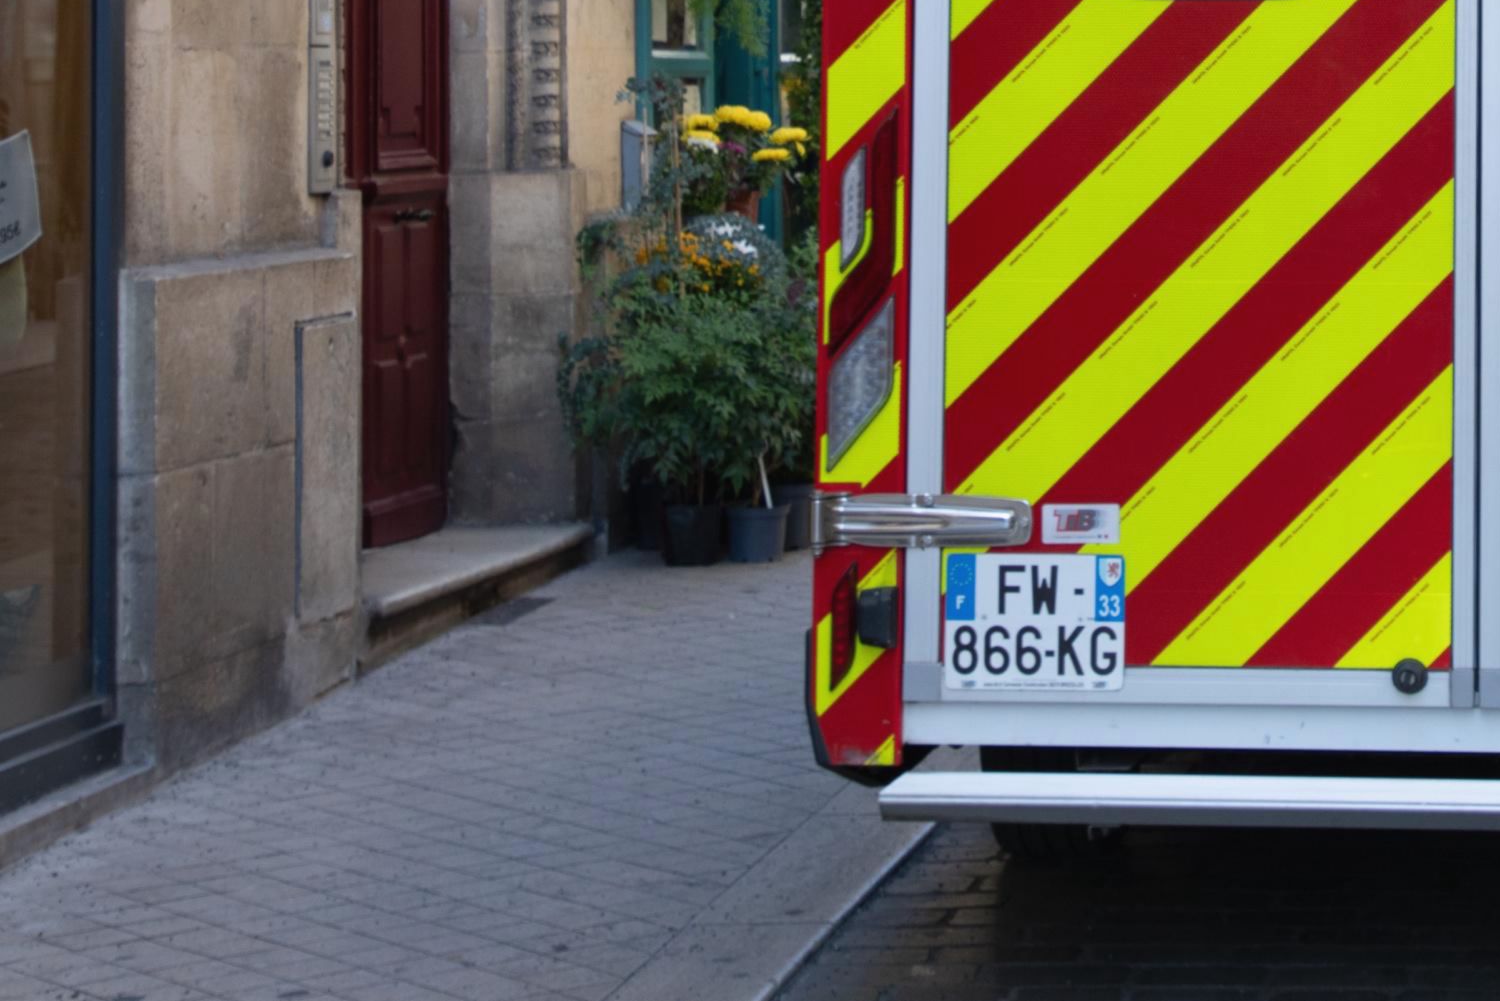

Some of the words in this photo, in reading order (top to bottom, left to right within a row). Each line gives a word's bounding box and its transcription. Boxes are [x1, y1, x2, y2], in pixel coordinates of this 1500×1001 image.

[955, 595, 966, 610] F
[1099, 594, 1121, 617] 33
[952, 625, 1118, 676] 866-KG
